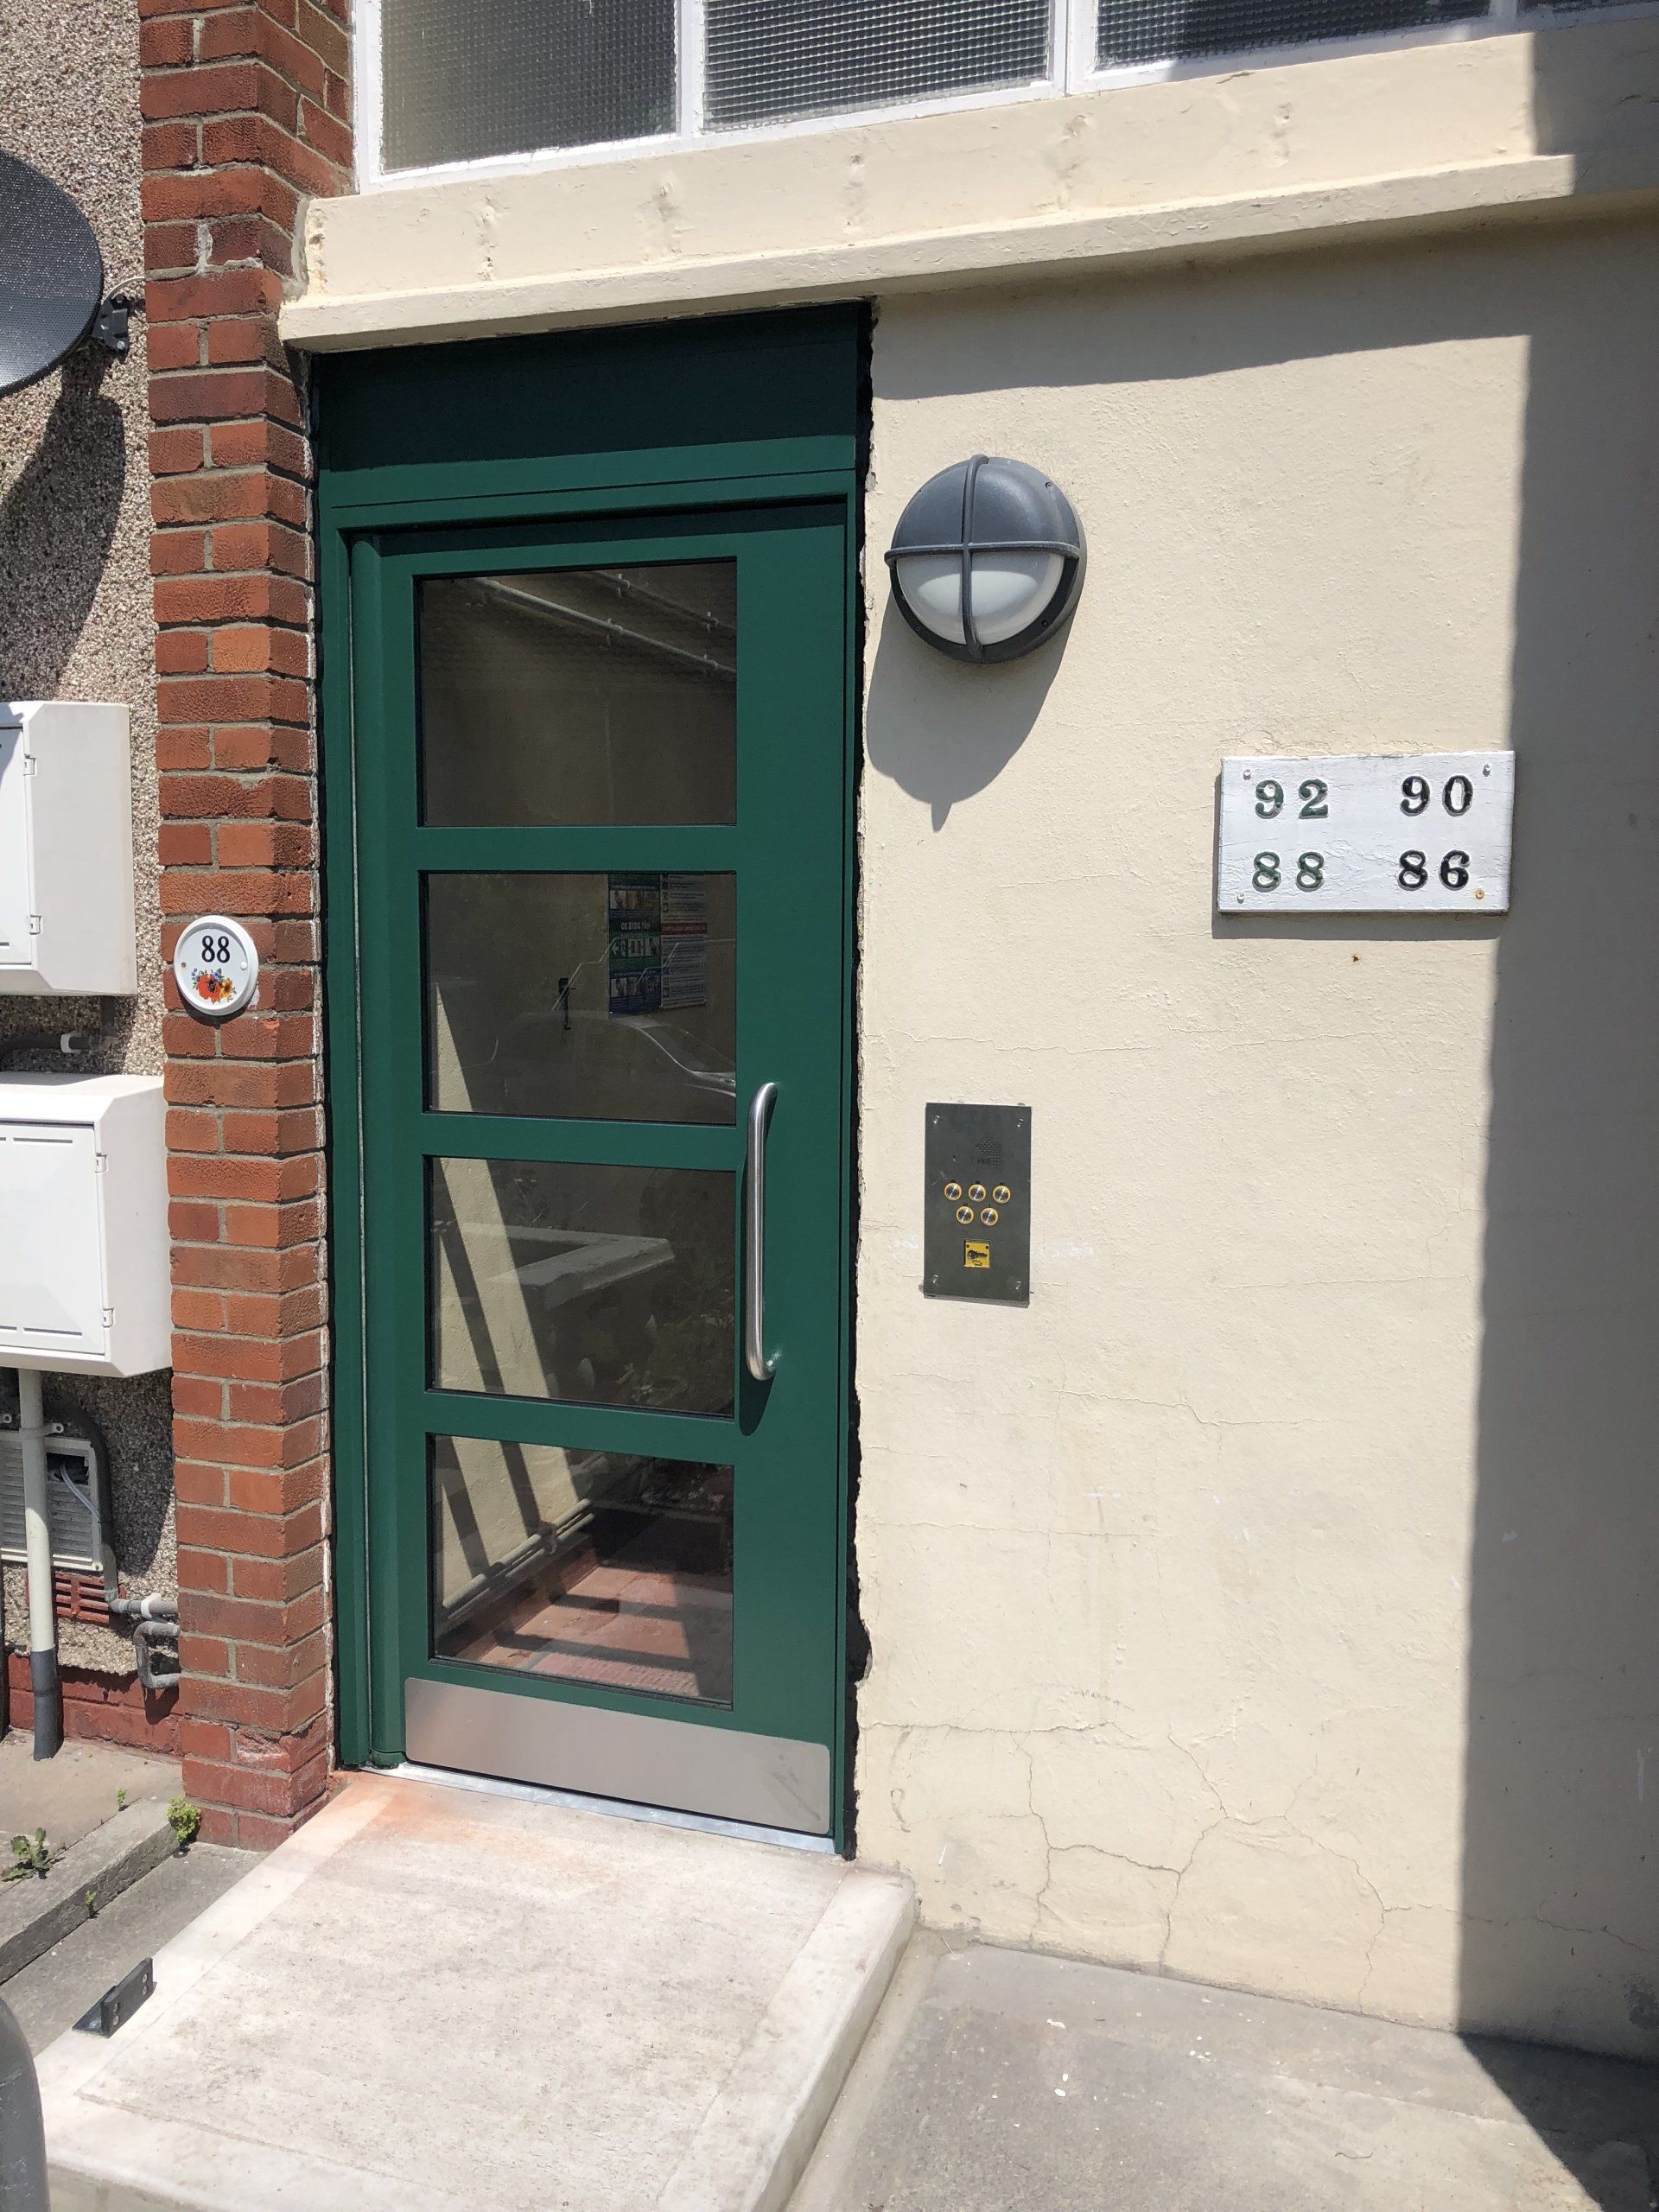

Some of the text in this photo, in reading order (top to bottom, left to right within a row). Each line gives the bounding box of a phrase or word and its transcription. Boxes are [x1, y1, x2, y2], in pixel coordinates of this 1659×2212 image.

[1255, 775, 1474, 819] 92 90
[1252, 849, 1471, 892] 88 86
[201, 935, 231, 963] 88
